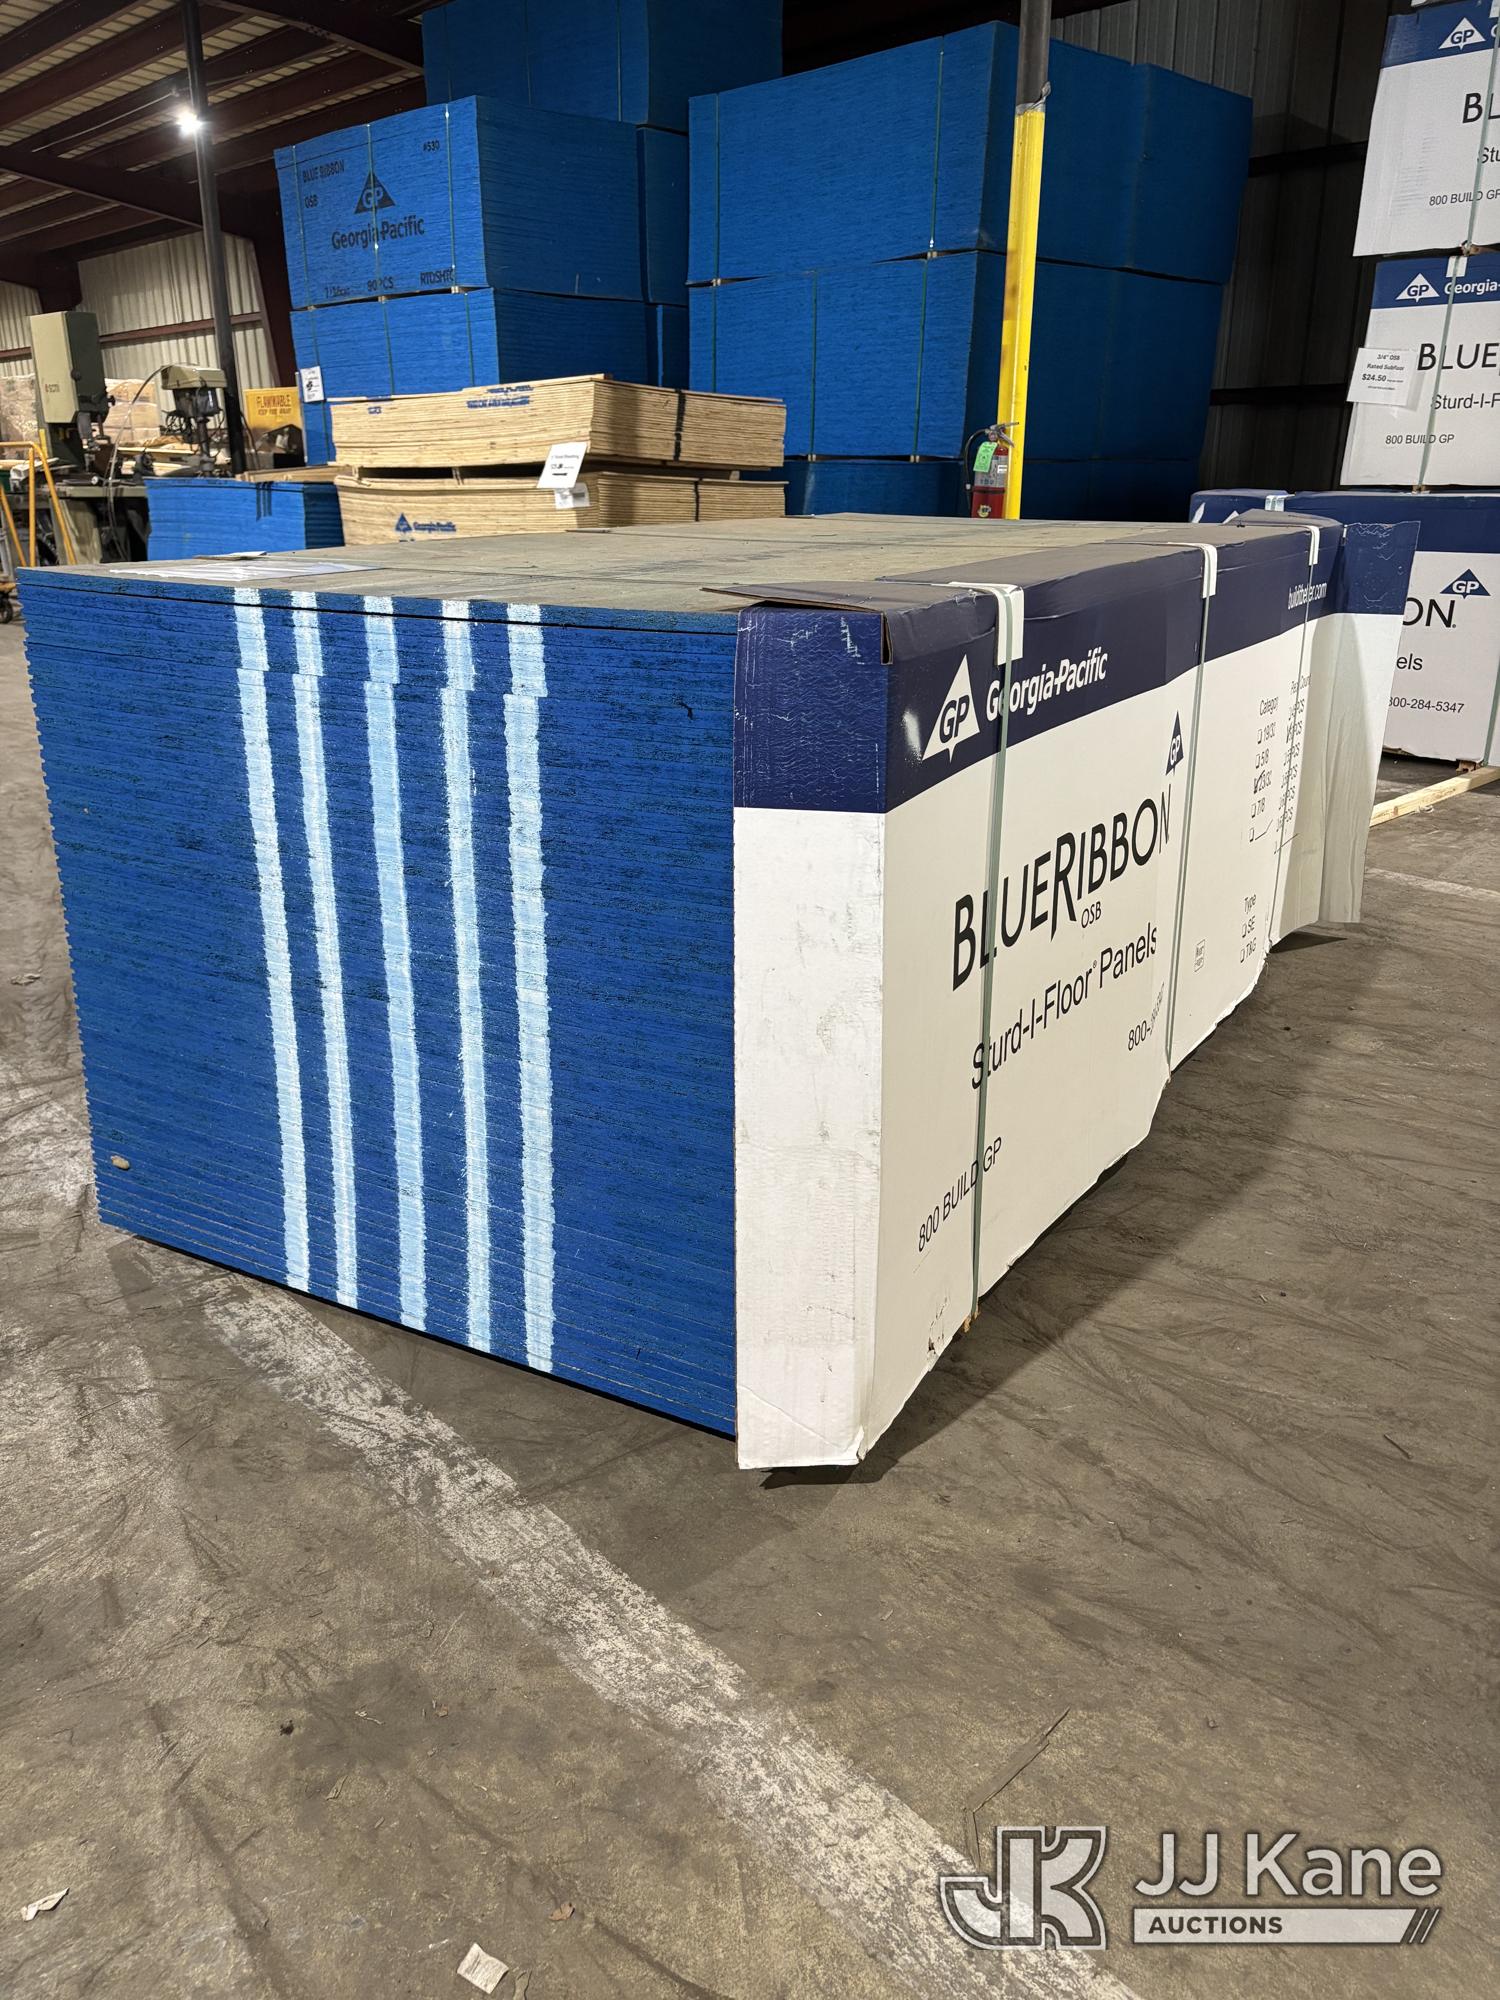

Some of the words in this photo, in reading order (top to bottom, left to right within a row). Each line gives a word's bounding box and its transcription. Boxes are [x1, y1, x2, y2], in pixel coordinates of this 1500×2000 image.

[1451, 29, 1475, 45] GP
[362, 186, 384, 209] GP
[1429, 194, 1448, 206] 800
[1450, 191, 1484, 204] BUILD
[1407, 284, 1430, 297] GP
[1361, 373, 1387, 382] $24.50
[1385, 434, 1404, 445] 800
[1405, 434, 1437, 444] BUILD
[1438, 433, 1455, 444] GP
[1452, 580, 1480, 594] GP
[939, 695, 969, 743] GP
[1170, 734, 1181, 766] GP
[953, 784, 1171, 991] BLUERIBBON
[1081, 901, 1102, 928] OSB
[1099, 922, 1157, 989] Panels
[918, 1205, 940, 1252] 800
[943, 1160, 980, 1221] BUILD
[982, 1136, 1002, 1172] GP
